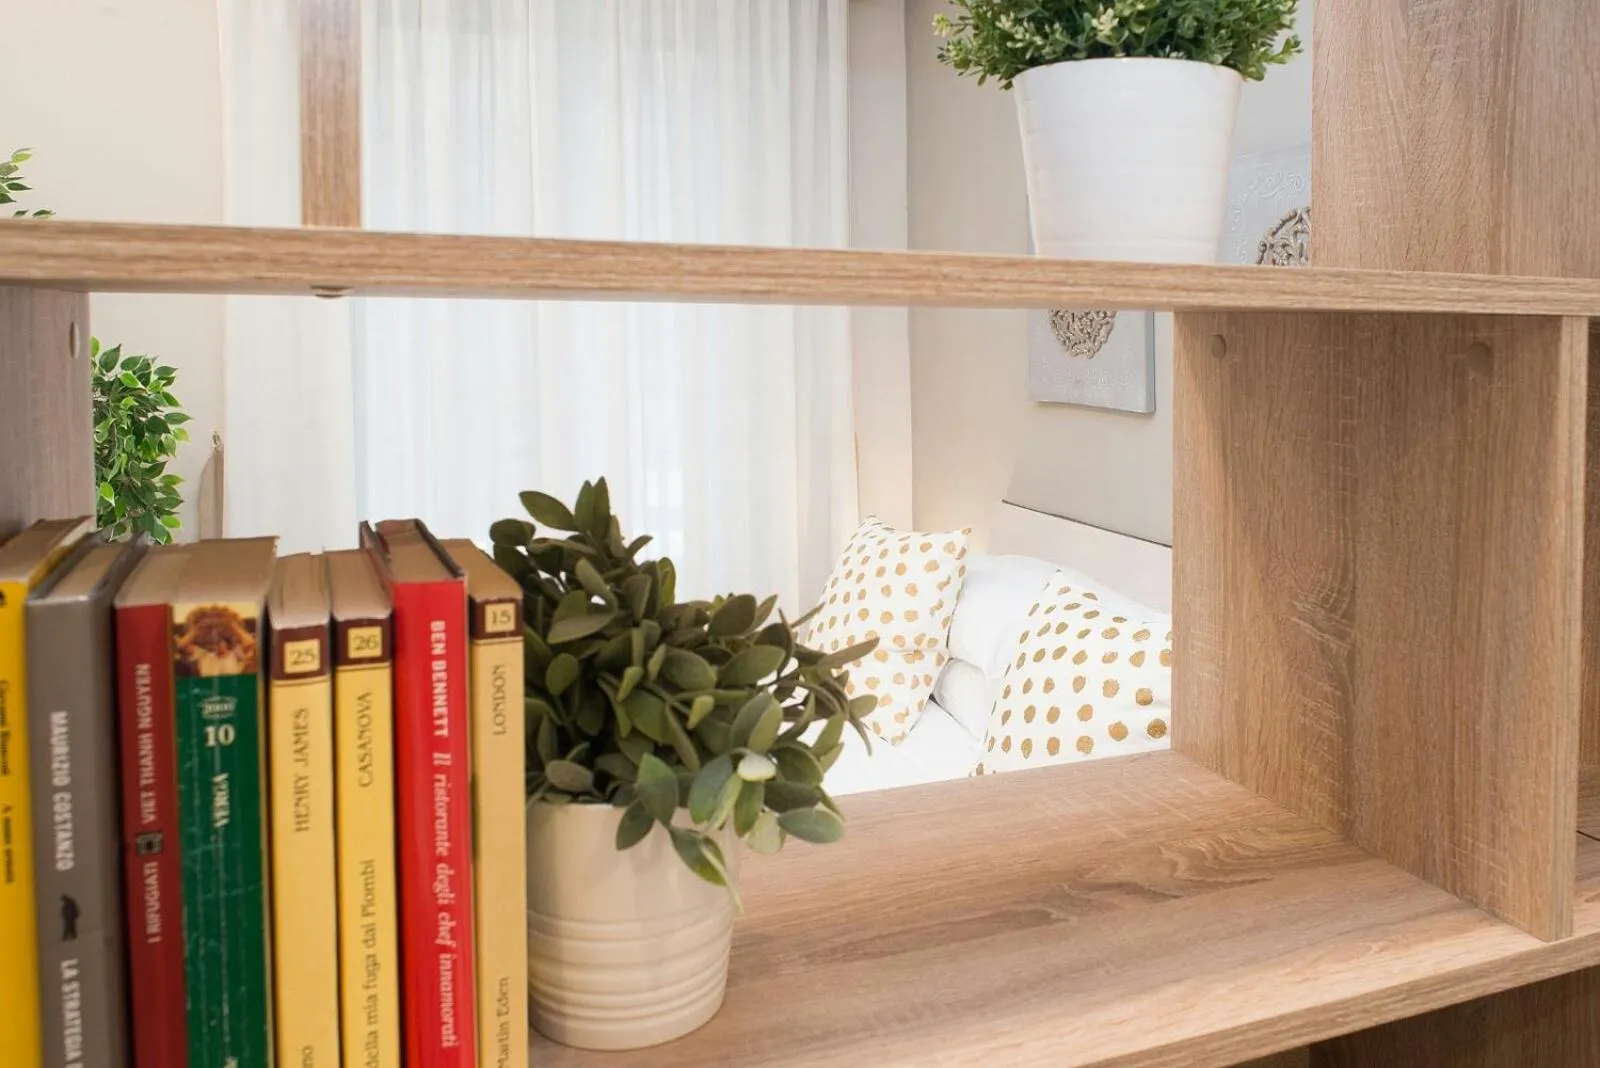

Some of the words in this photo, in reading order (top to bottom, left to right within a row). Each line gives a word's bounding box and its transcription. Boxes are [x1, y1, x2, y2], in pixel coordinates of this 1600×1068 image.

[430, 620, 446, 655] BEN
[491, 609, 511, 625] 15
[290, 648, 315, 666] 25
[353, 634, 379, 650] 26
[135, 663, 153, 729] NGUYEN
[431, 660, 449, 738] BENNETT
[491, 664, 507, 737] LONDON
[50, 710, 72, 787] MAURIZIO
[138, 732, 156, 788] THANH
[203, 724, 236, 747] 10
[291, 707, 310, 769] JAMES
[356, 690, 374, 788] CASANOVA
[433, 752, 452, 766] Il
[140, 790, 157, 825] VIET
[211, 771, 231, 828] VERGA
[292, 774, 311, 833] HENRY
[432, 774, 453, 857] ristorante
[52, 791, 75, 872] COSTANZO
[143, 861, 162, 934] RIFUGIATI
[359, 858, 376, 918] Piombi
[432, 862, 455, 905] degli
[147, 935, 162, 944] I
[361, 922, 377, 949] dai
[434, 912, 457, 949] chef
[60, 958, 80, 979] LA
[363, 953, 381, 991] fuga
[363, 993, 378, 1027] mia
[439, 953, 459, 1048] innamorati
[496, 976, 512, 1016] Eden
[61, 981, 83, 1062] STRATEGIA
